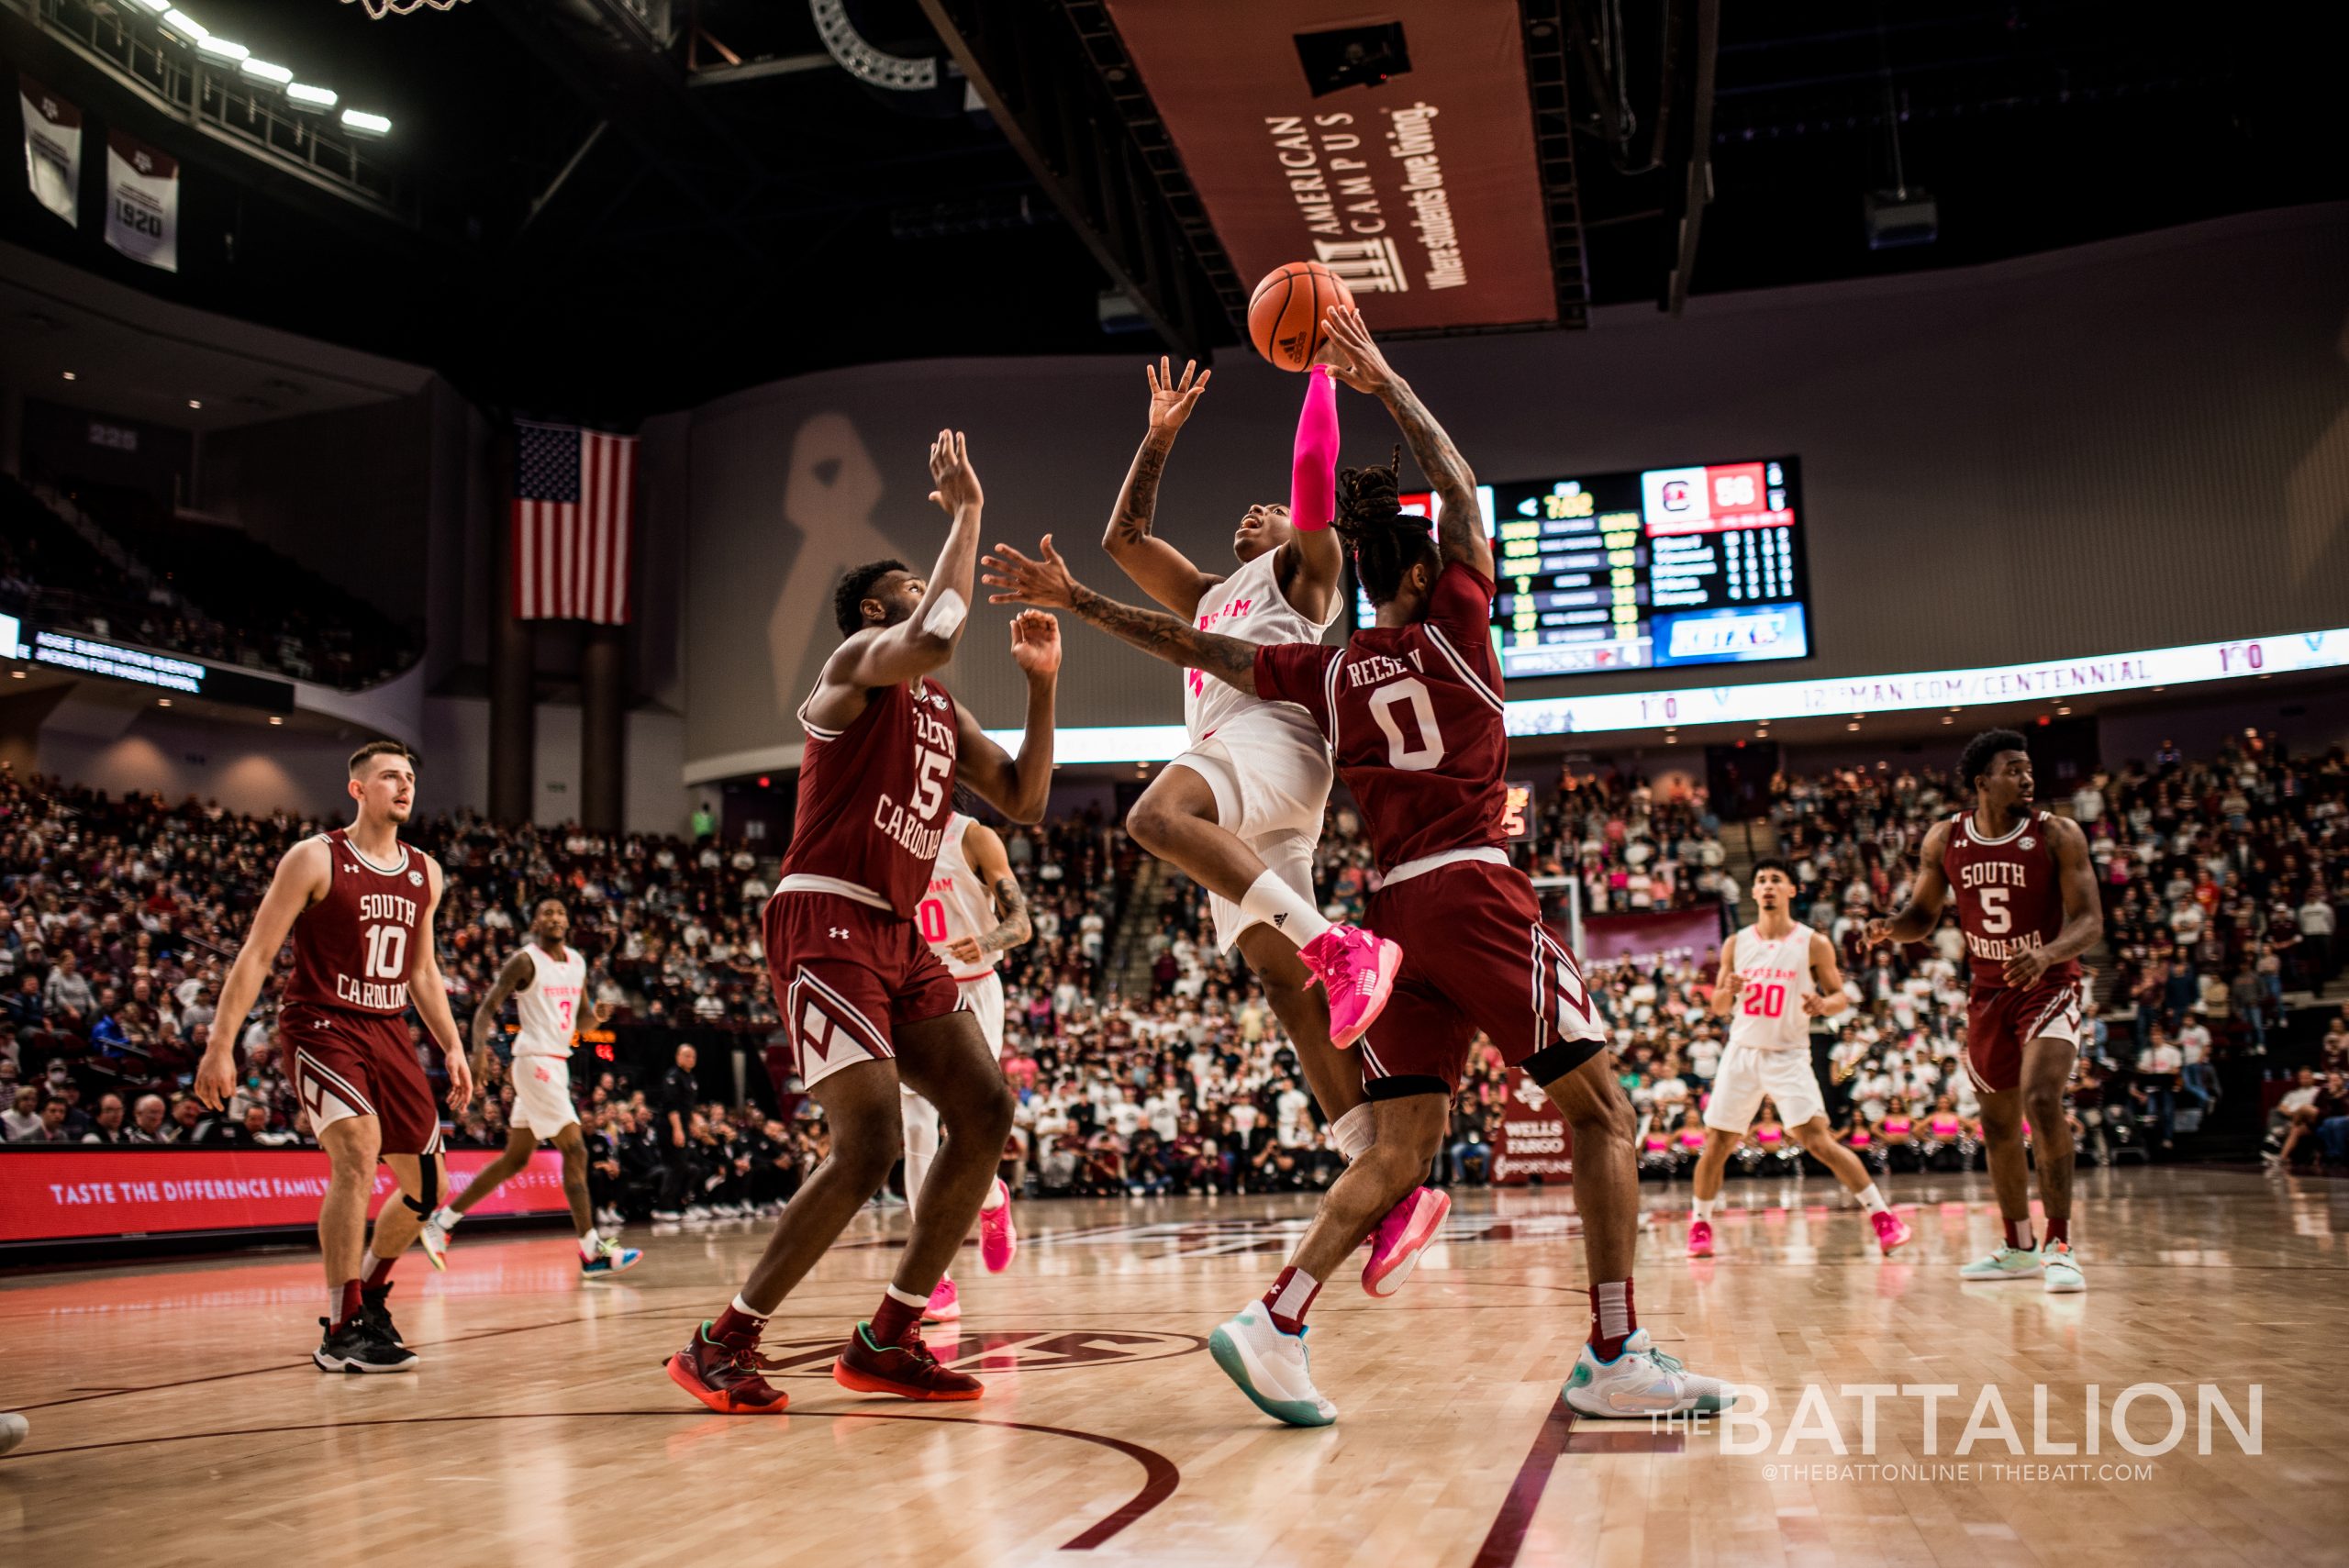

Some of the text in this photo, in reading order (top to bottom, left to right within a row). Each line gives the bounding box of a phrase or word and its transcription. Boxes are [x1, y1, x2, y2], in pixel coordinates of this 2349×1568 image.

[1265, 117, 1343, 235] AMERICAN
[1314, 112, 1386, 234] CAMPUS
[1400, 154, 1443, 192] love
[115, 198, 163, 239] 1920
[1408, 189, 1458, 249] students
[1425, 248, 1467, 290] Where
[1346, 649, 1424, 687] REESE V
[1368, 677, 1445, 771] 0
[1961, 862, 2027, 889] SOUTH
[359, 894, 417, 929] SOUTH
[1979, 887, 2012, 934] 5
[365, 924, 407, 979] 10
[337, 973, 410, 1010] CAROLIN
[1744, 983, 1786, 1018] 20
[559, 1000, 572, 1030] 3
[1504, 1120, 1564, 1138] WELLS
[1506, 1138, 1565, 1154] FARGO
[50, 1177, 329, 1205] TASTE THE DIFFERENCE FAMILY
